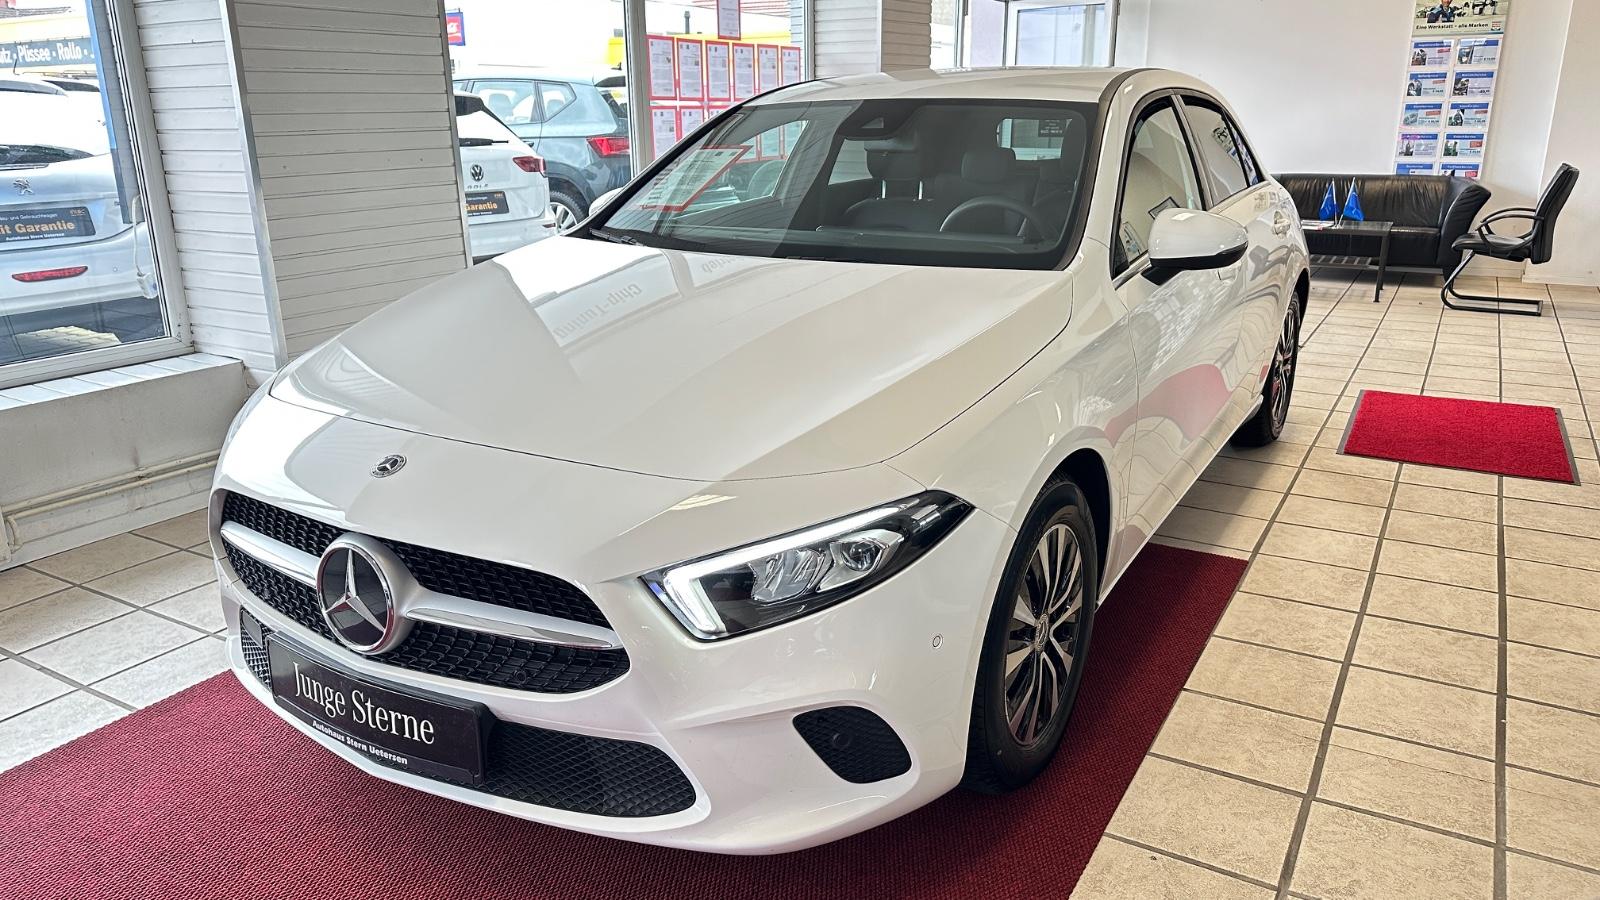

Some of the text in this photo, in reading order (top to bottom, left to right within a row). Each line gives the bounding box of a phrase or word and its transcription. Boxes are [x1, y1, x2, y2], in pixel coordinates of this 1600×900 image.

[16, 44, 52, 63] Plissee
[56, 41, 82, 61] Rollo
[15, 220, 76, 234] Garantie
[292, 661, 435, 745] Junge Sterne
[312, 720, 408, 765] Autohaus Stern Uetersen
